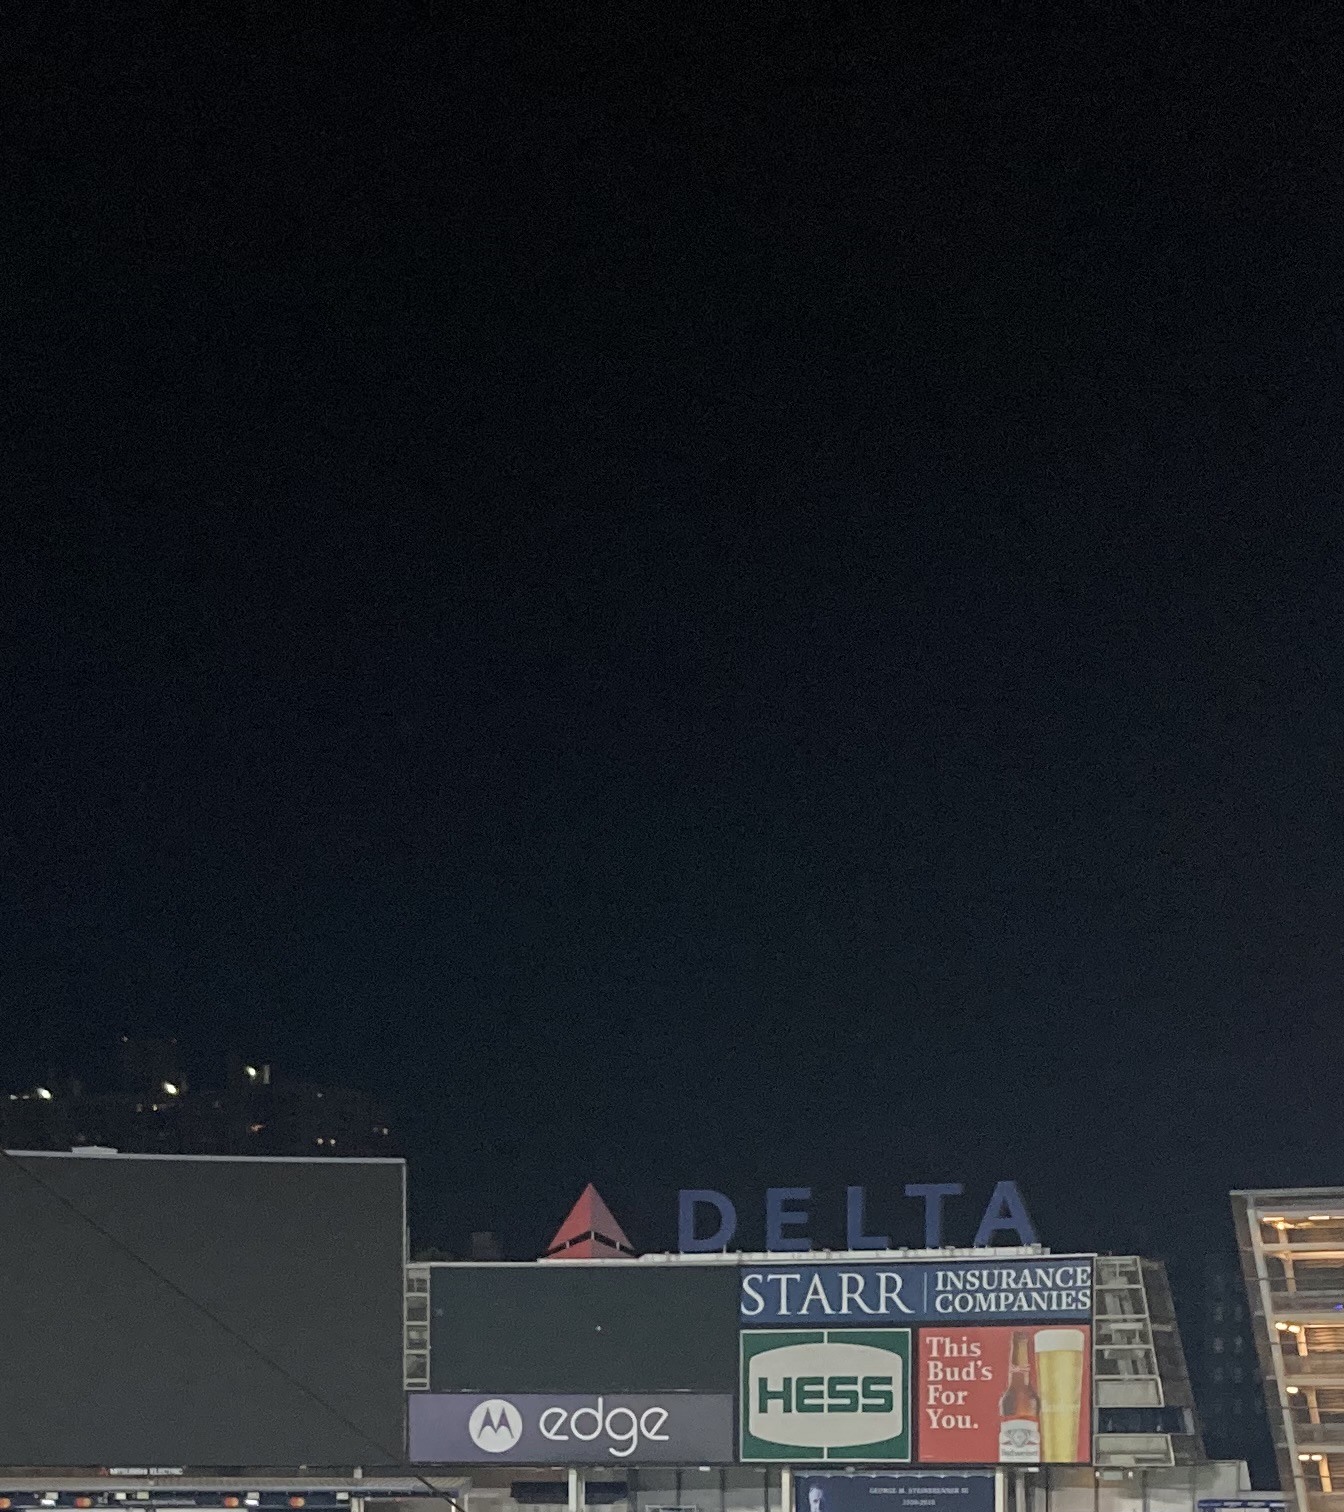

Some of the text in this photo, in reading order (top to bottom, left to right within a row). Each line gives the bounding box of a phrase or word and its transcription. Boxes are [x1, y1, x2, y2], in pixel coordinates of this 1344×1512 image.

[677, 1180, 1038, 1253] DELTA
[741, 1266, 1091, 1315] STARR INSURANCE
[935, 1289, 1091, 1313] COMPANIES
[926, 1335, 981, 1358] This
[927, 1360, 993, 1382] Bud's
[758, 1376, 894, 1414] HESS
[927, 1385, 968, 1406] For
[538, 1396, 670, 1457] edge
[926, 1409, 979, 1430] You.
